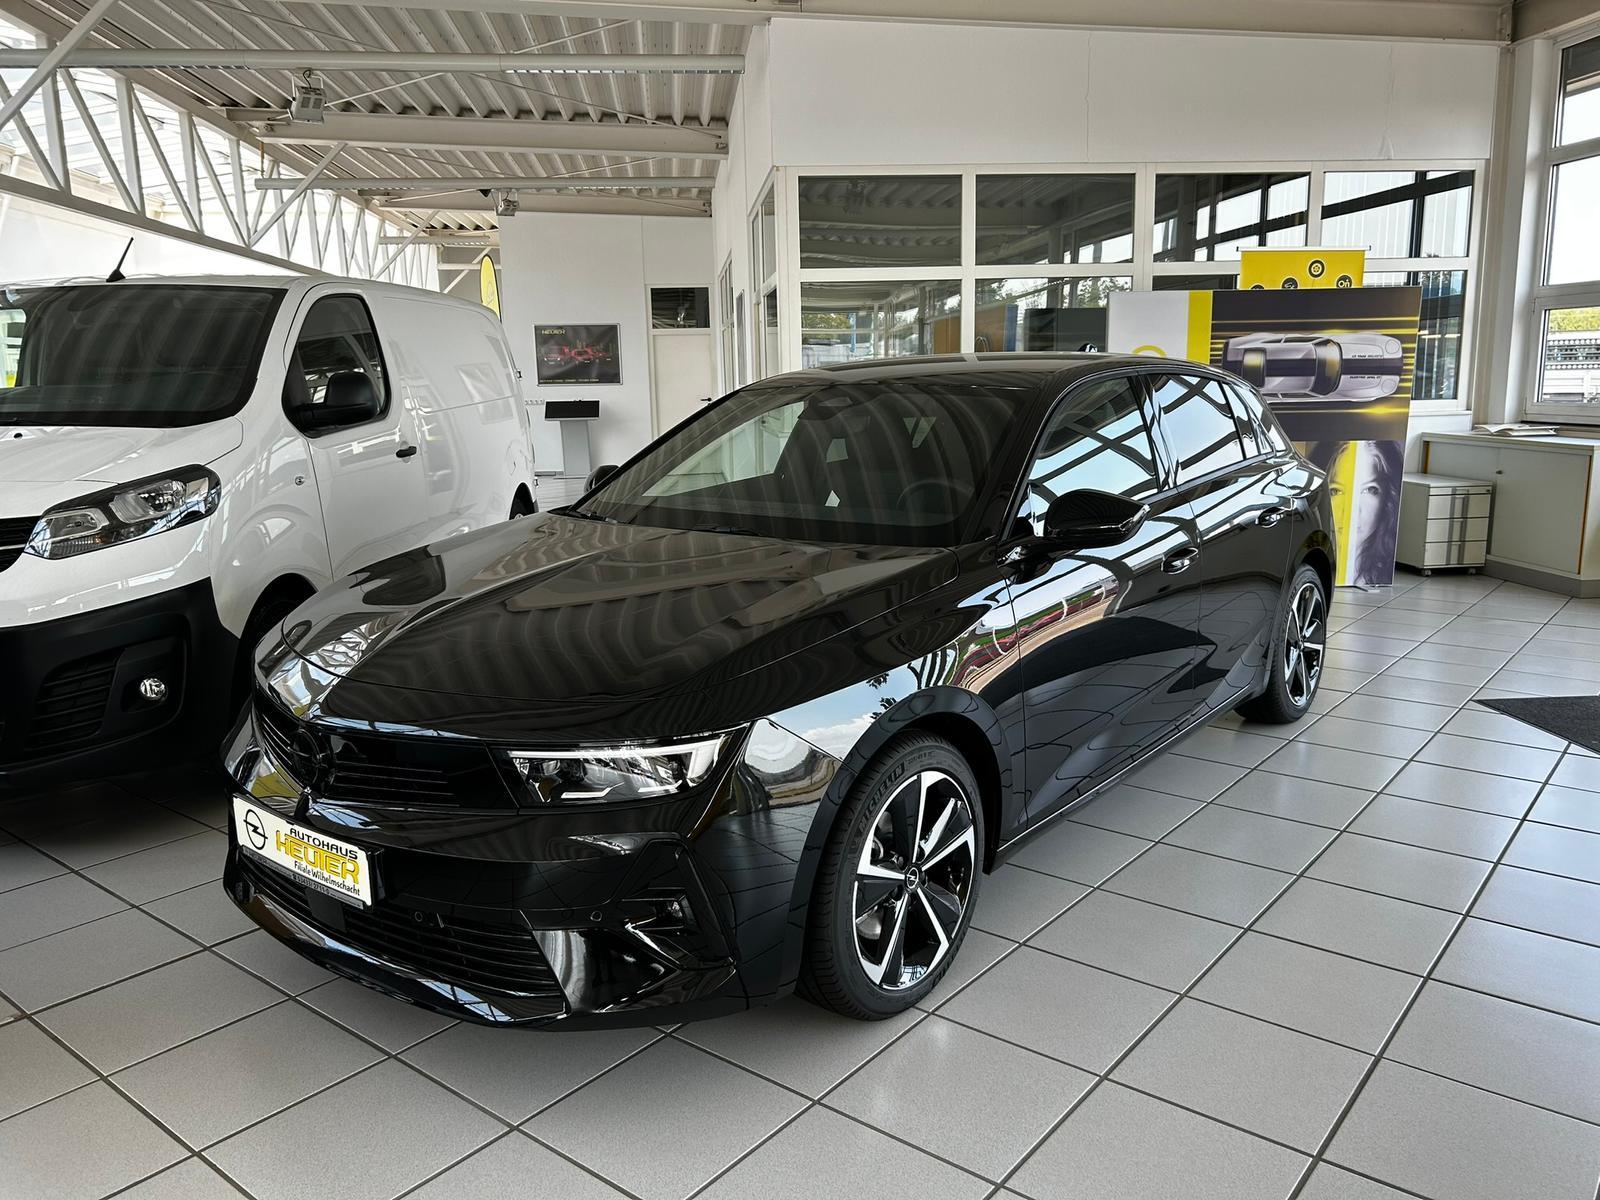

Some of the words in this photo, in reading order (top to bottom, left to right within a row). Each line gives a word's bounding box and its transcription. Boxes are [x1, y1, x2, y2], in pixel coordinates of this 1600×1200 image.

[859, 761, 905, 833] MICHELIN
[276, 830, 360, 884] HEUTER
[290, 827, 358, 860] AUTOHAUS
[294, 860, 311, 875] Filiale
[311, 867, 360, 896] Wilhelmschacht
